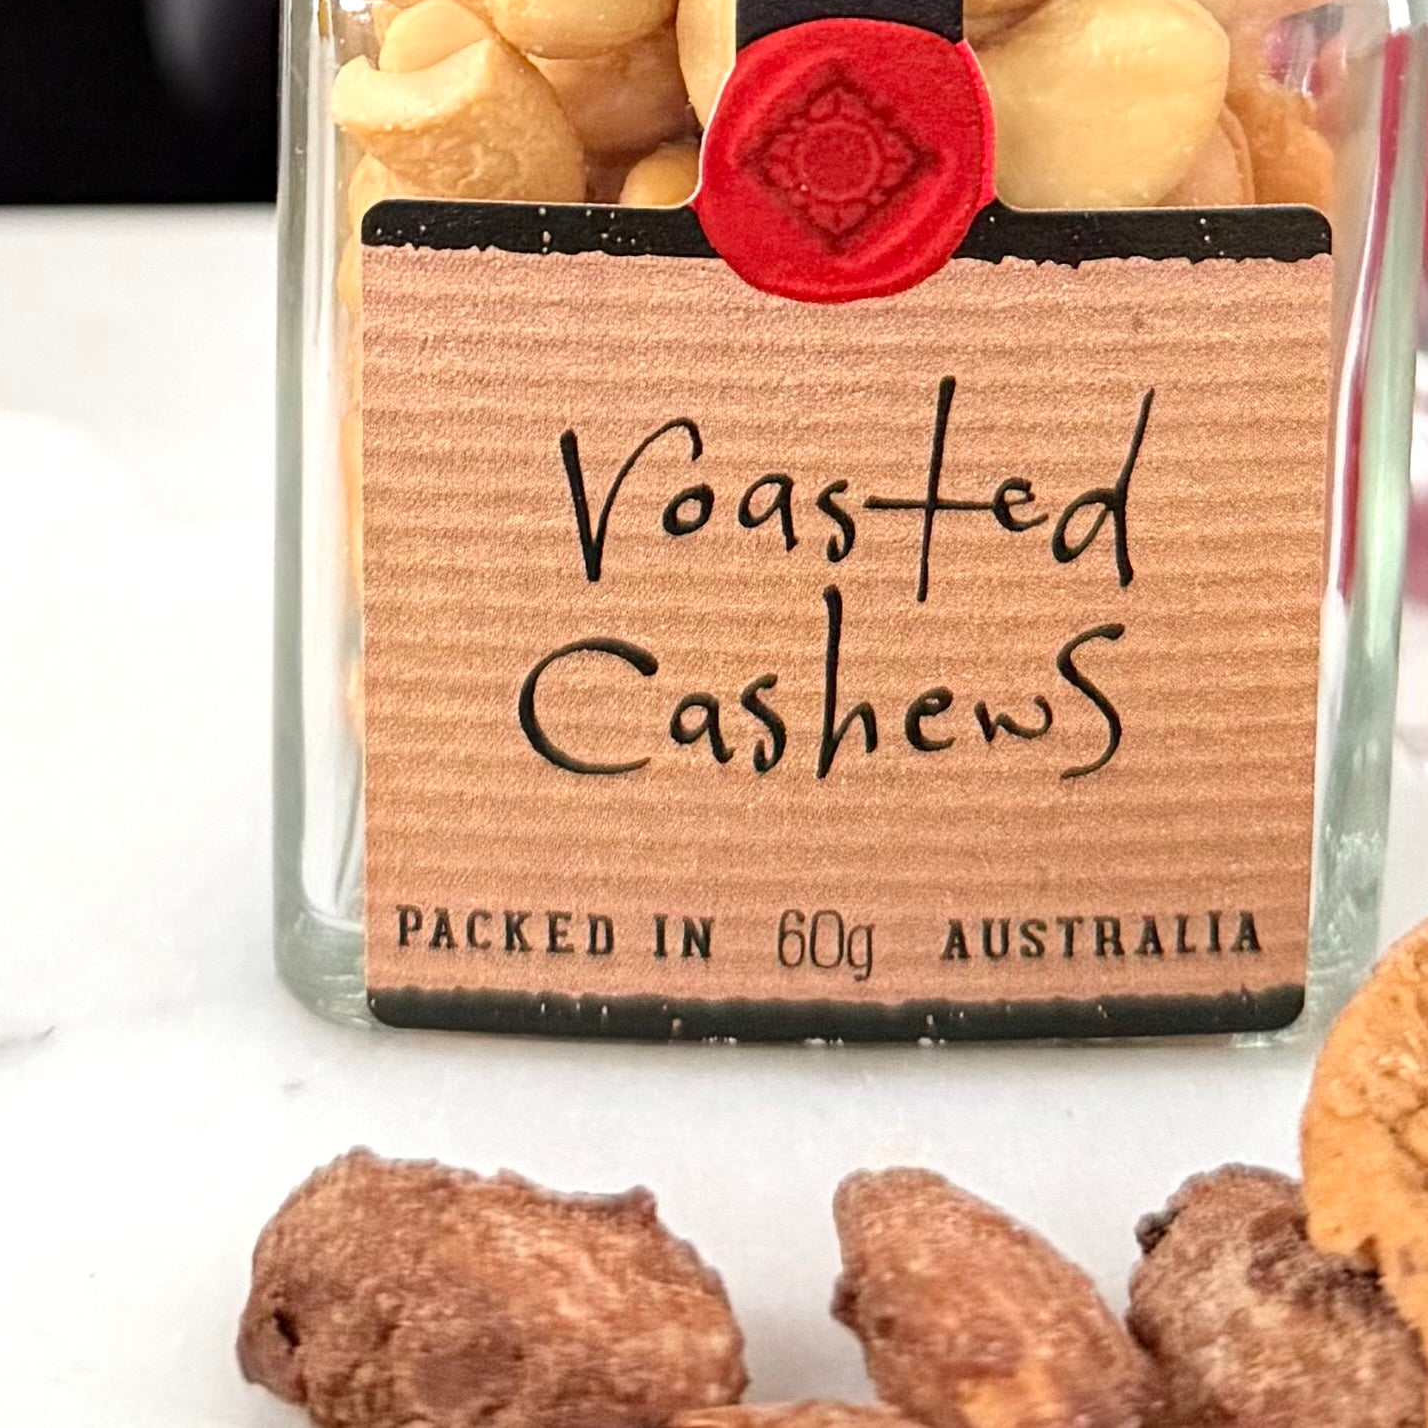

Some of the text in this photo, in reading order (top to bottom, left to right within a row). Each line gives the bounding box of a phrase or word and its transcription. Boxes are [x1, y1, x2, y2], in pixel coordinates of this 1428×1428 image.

[558, 375, 1156, 604] roasted
[396, 904, 1264, 983] PACKED IN 60g AUSTRALIA
